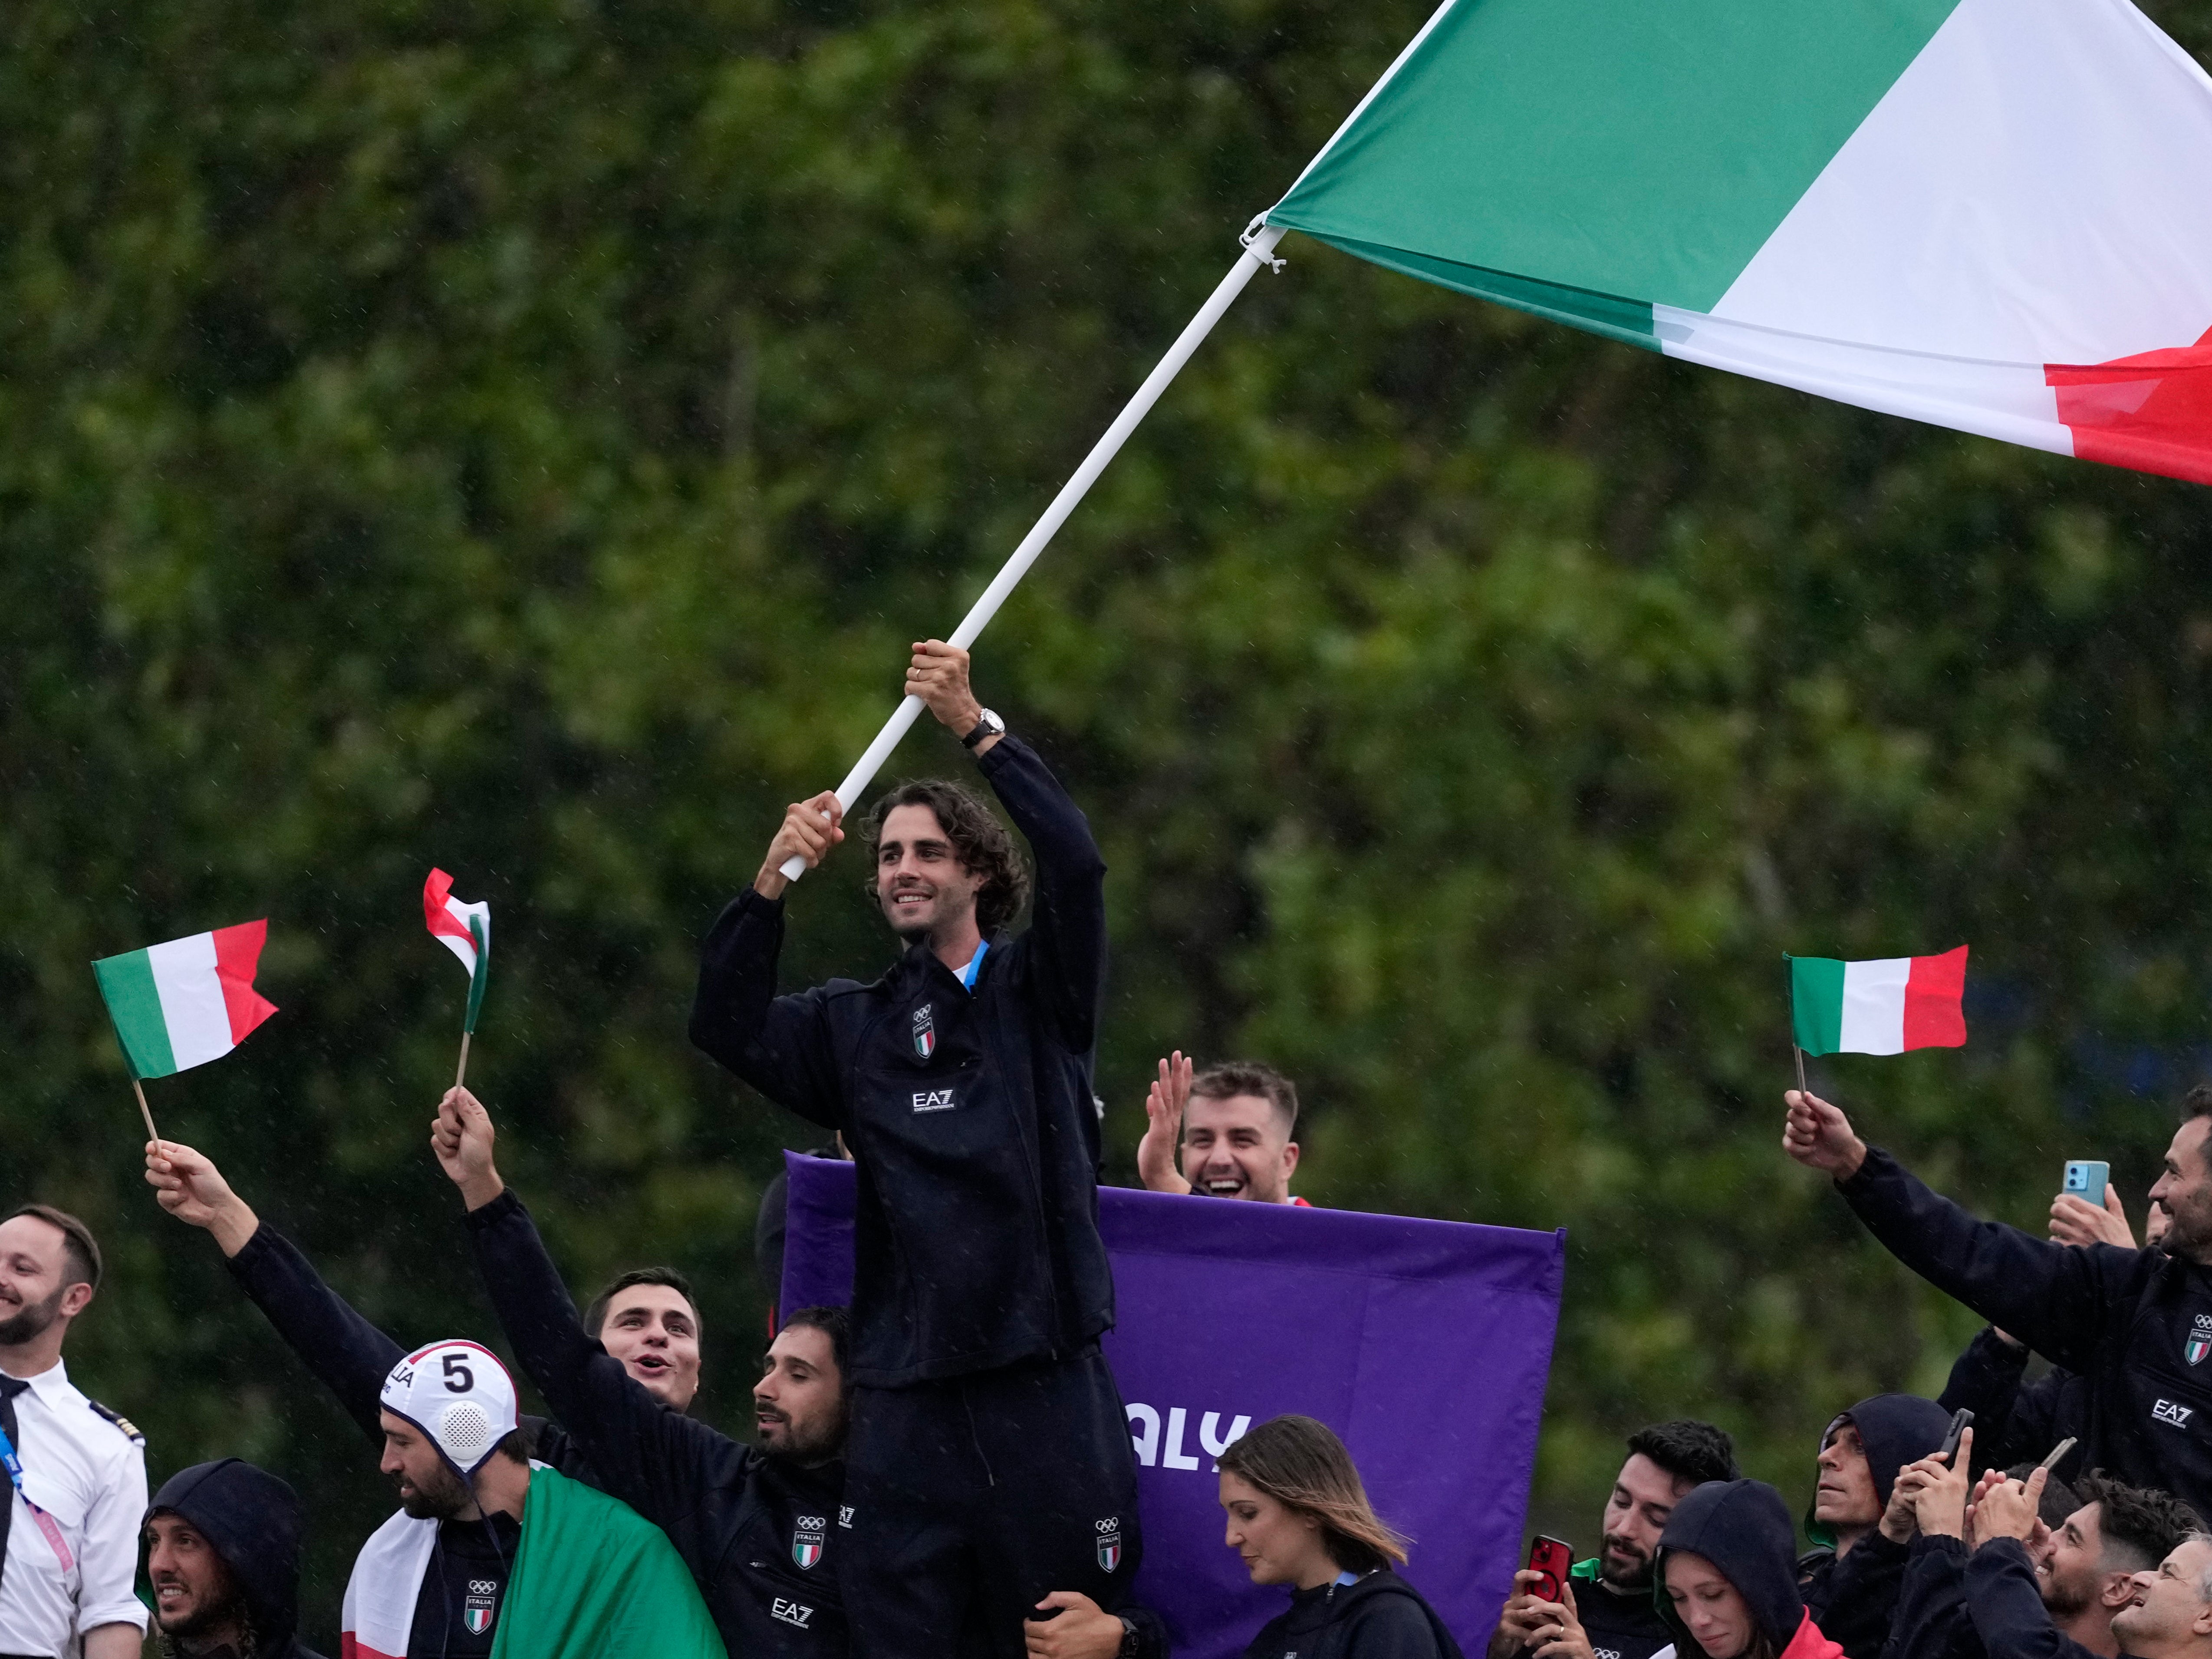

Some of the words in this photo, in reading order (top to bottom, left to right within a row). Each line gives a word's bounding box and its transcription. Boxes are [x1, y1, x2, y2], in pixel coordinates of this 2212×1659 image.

[913, 1090, 953, 1107] EA7
[442, 1353, 474, 1393] 5
[2153, 1399, 2193, 1422] EA7
[1099, 1536, 1119, 1544] ITALIA
[772, 1597, 814, 1623] EA7
